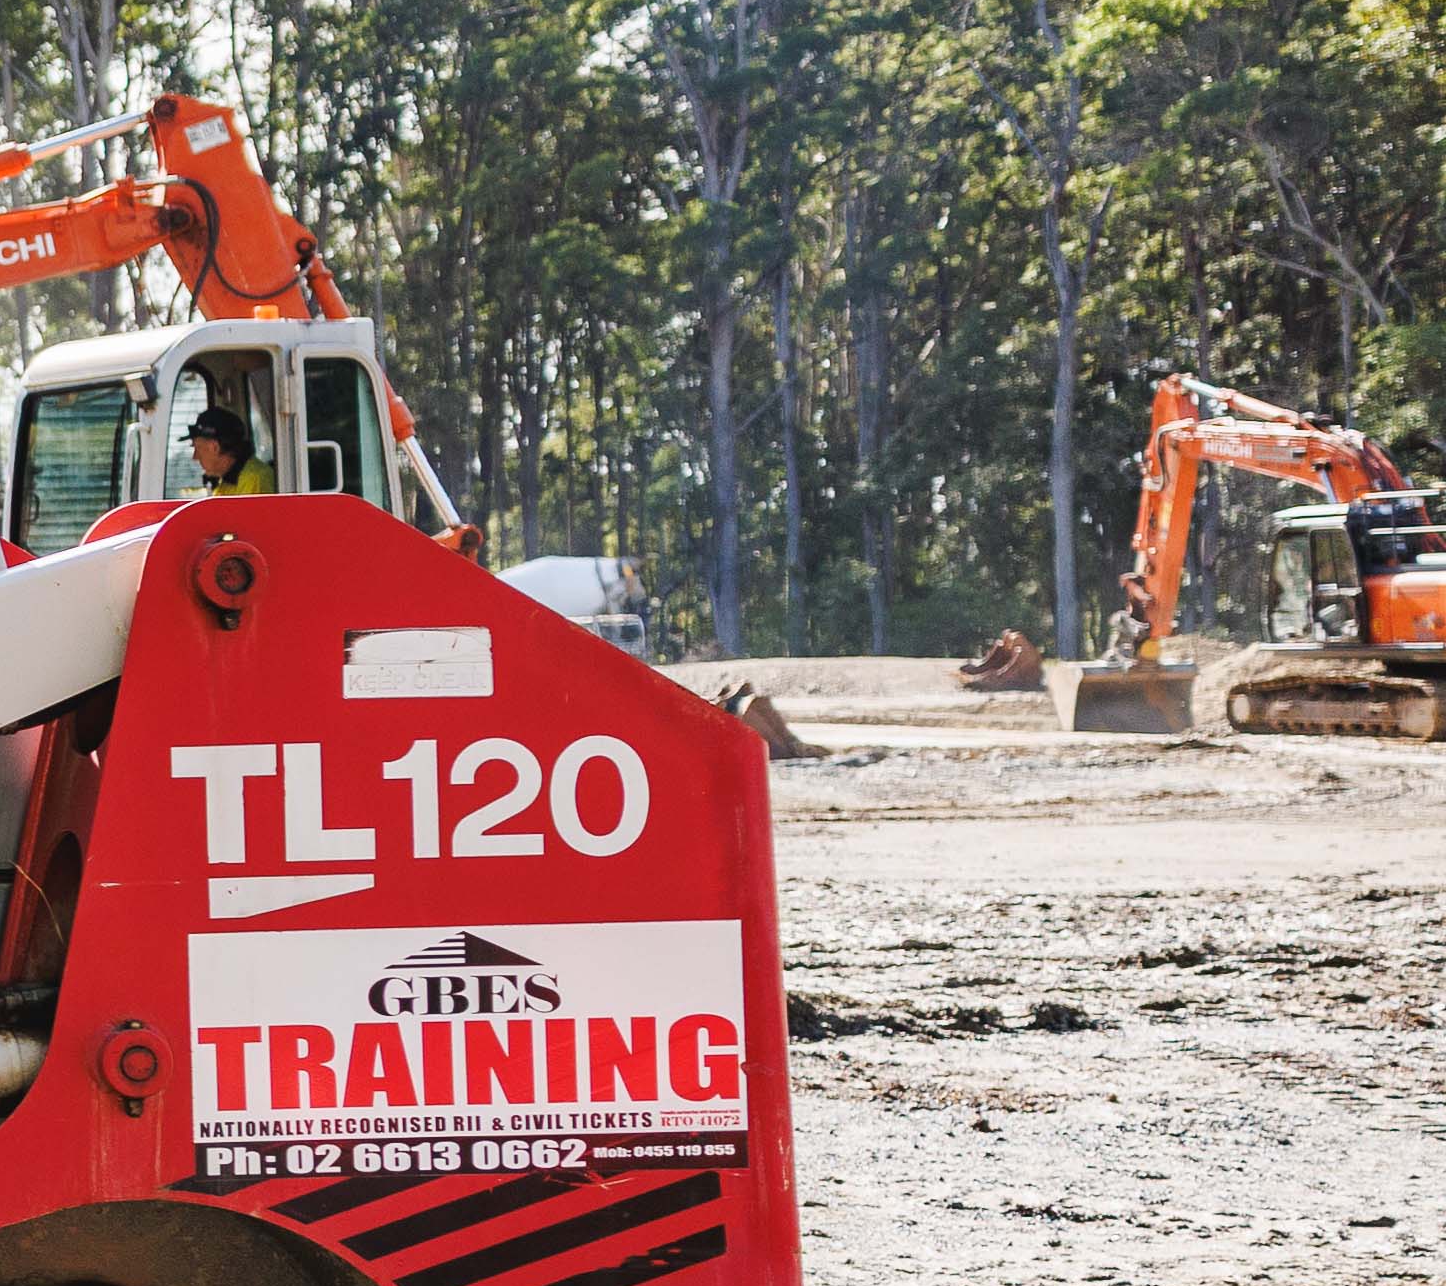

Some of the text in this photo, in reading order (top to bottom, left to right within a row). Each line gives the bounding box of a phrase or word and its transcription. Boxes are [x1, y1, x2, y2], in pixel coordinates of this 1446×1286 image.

[349, 673, 406, 692] KEEP
[368, 973, 562, 1016] GBES
[197, 1013, 741, 1112] TRAINING
[199, 1112, 652, 1138] NATIONALLY RECOGNISED RII & CIVIL TICKETS
[661, 1116, 694, 1127] RTO
[206, 1138, 587, 1176] Ph: 02 6613 0662
[593, 1146, 631, 1159] Mob:
[633, 1145, 674, 1157] 0455
[676, 1145, 702, 1156] 119
